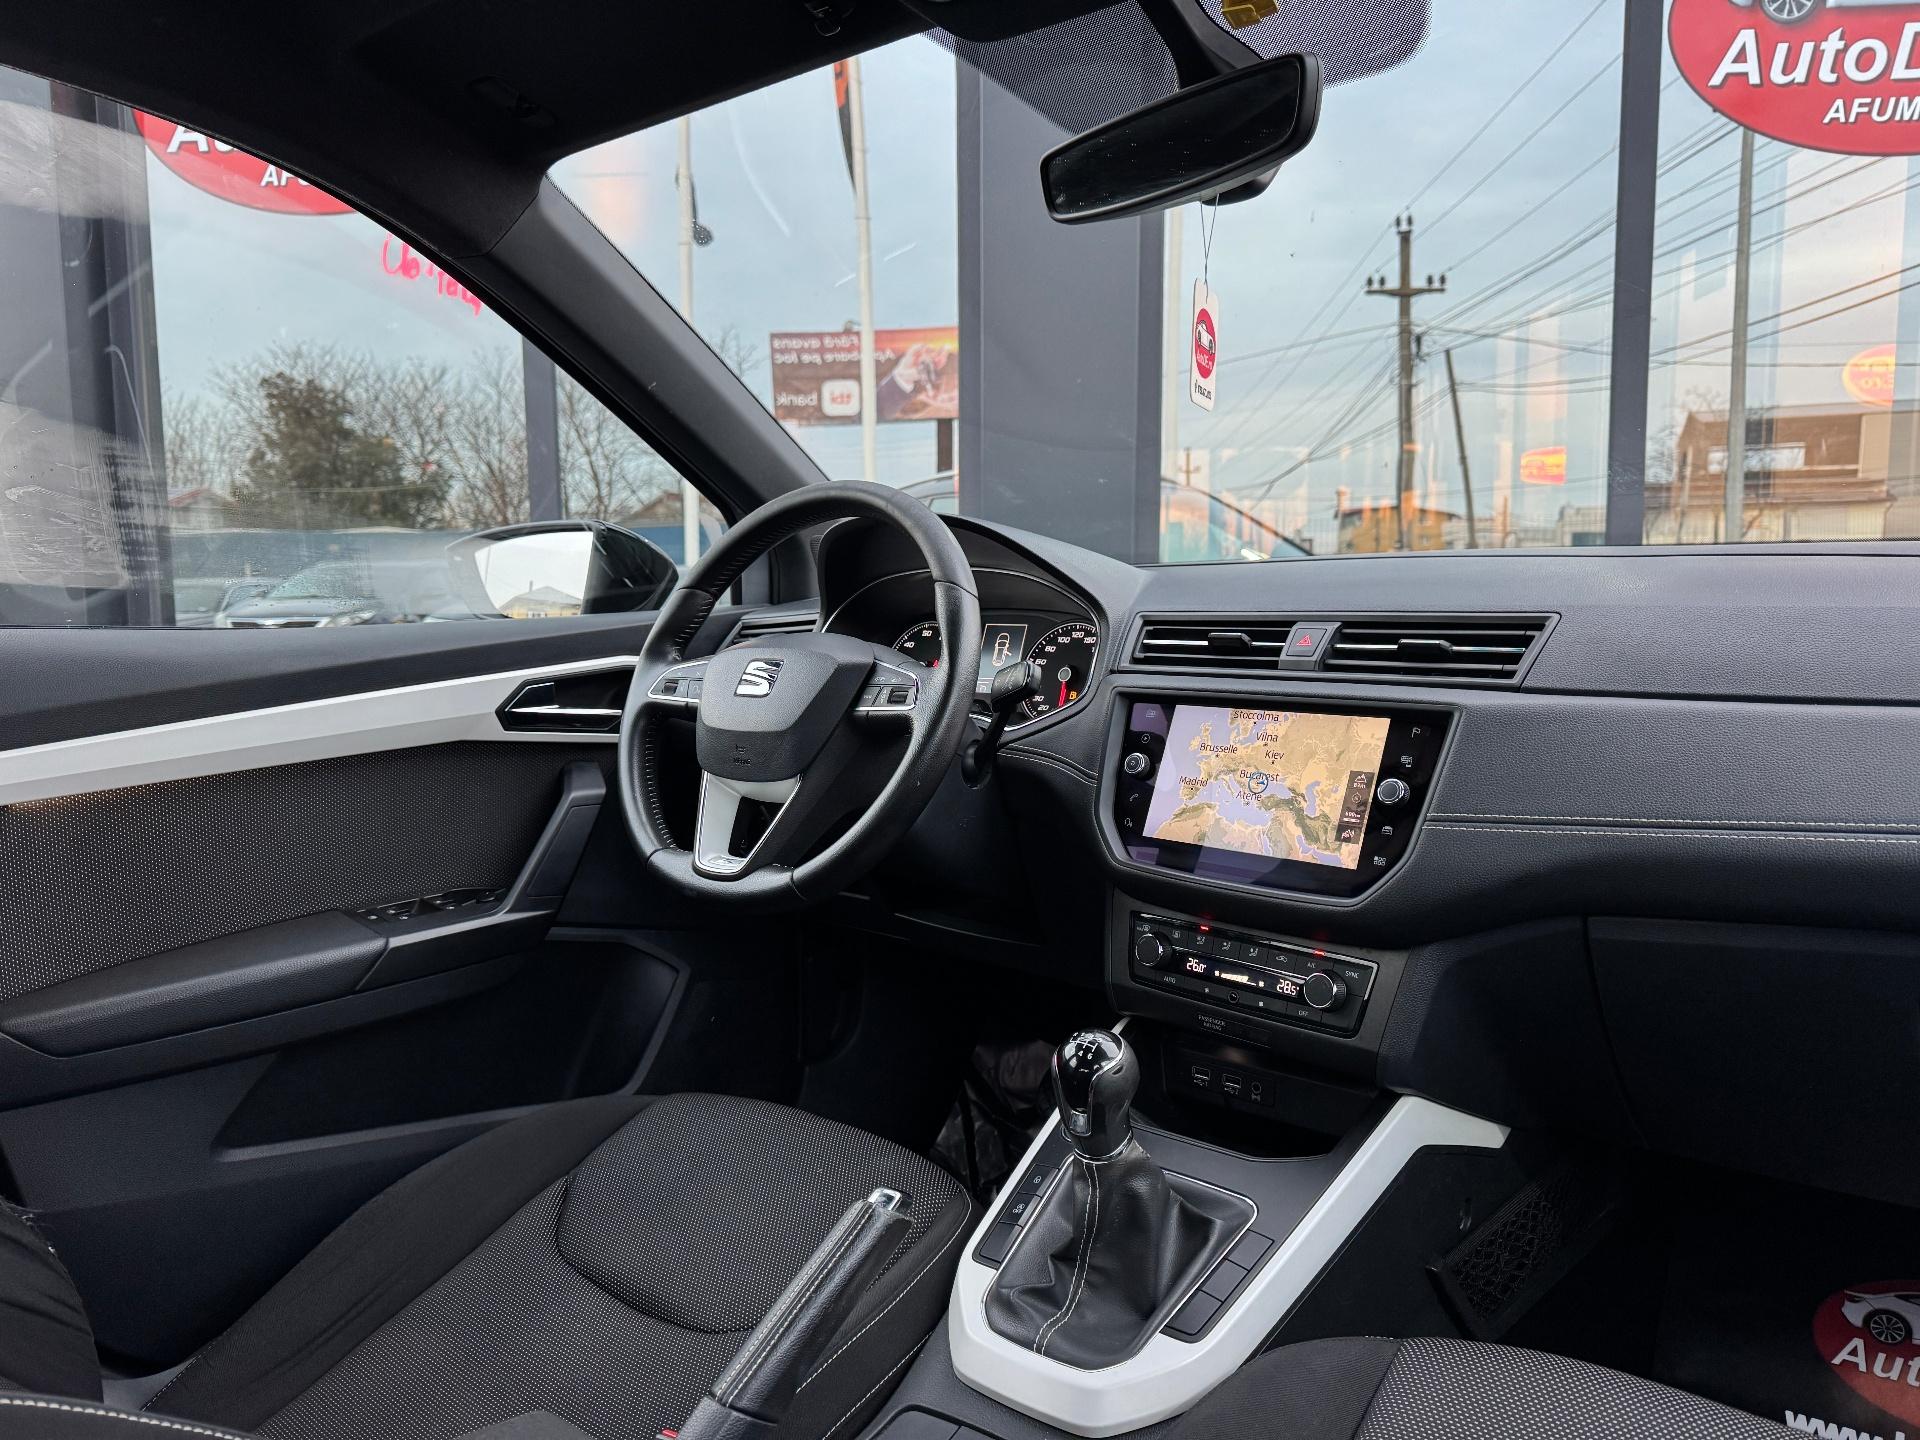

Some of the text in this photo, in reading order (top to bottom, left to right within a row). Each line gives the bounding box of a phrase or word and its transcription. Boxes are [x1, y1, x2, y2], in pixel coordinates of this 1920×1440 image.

[1823, 96, 1920, 124] AFUM
[1057, 636, 1071, 644] 100
[1044, 645, 1057, 653] 80
[1233, 710, 1280, 722] Stoccolma
[1256, 731, 1279, 743] Vilna
[1200, 742, 1238, 754] Brusselle
[1264, 749, 1285, 760] Kiev
[1179, 775, 1209, 787] Madrid
[1236, 790, 1262, 802] Atene
[1163, 974, 1177, 984] AUTO
[1345, 970, 1360, 979] SYNC
